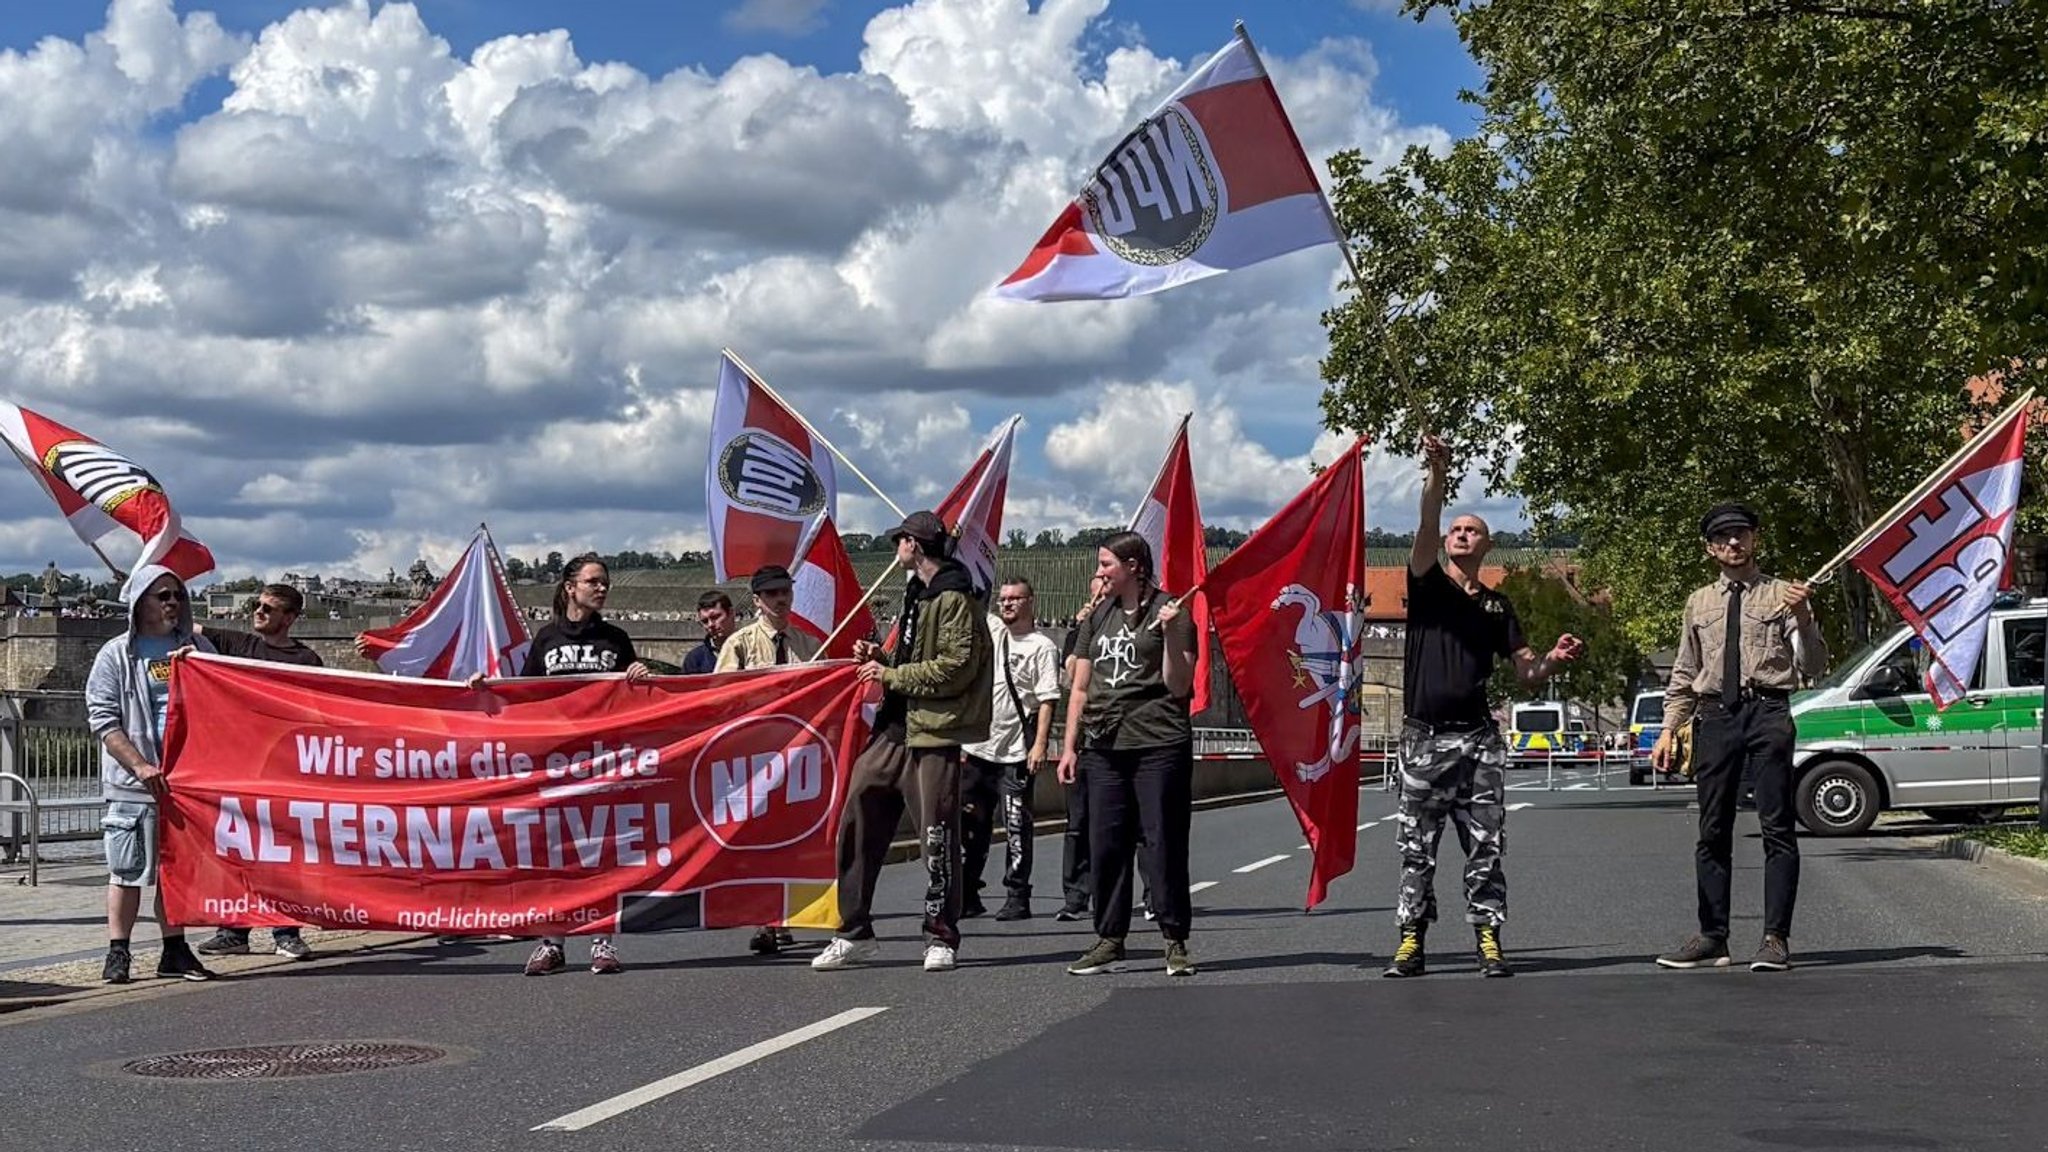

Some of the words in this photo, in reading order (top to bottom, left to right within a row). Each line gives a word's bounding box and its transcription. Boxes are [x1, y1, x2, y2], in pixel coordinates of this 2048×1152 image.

[296, 734, 363, 777] Wir
[375, 738, 458, 779] sind
[470, 741, 533, 780] die
[546, 741, 660, 779] echte
[711, 742, 822, 826] NPD
[214, 796, 672, 870] ALTERNATIVE!
[204, 893, 370, 925] npd-kronach.de
